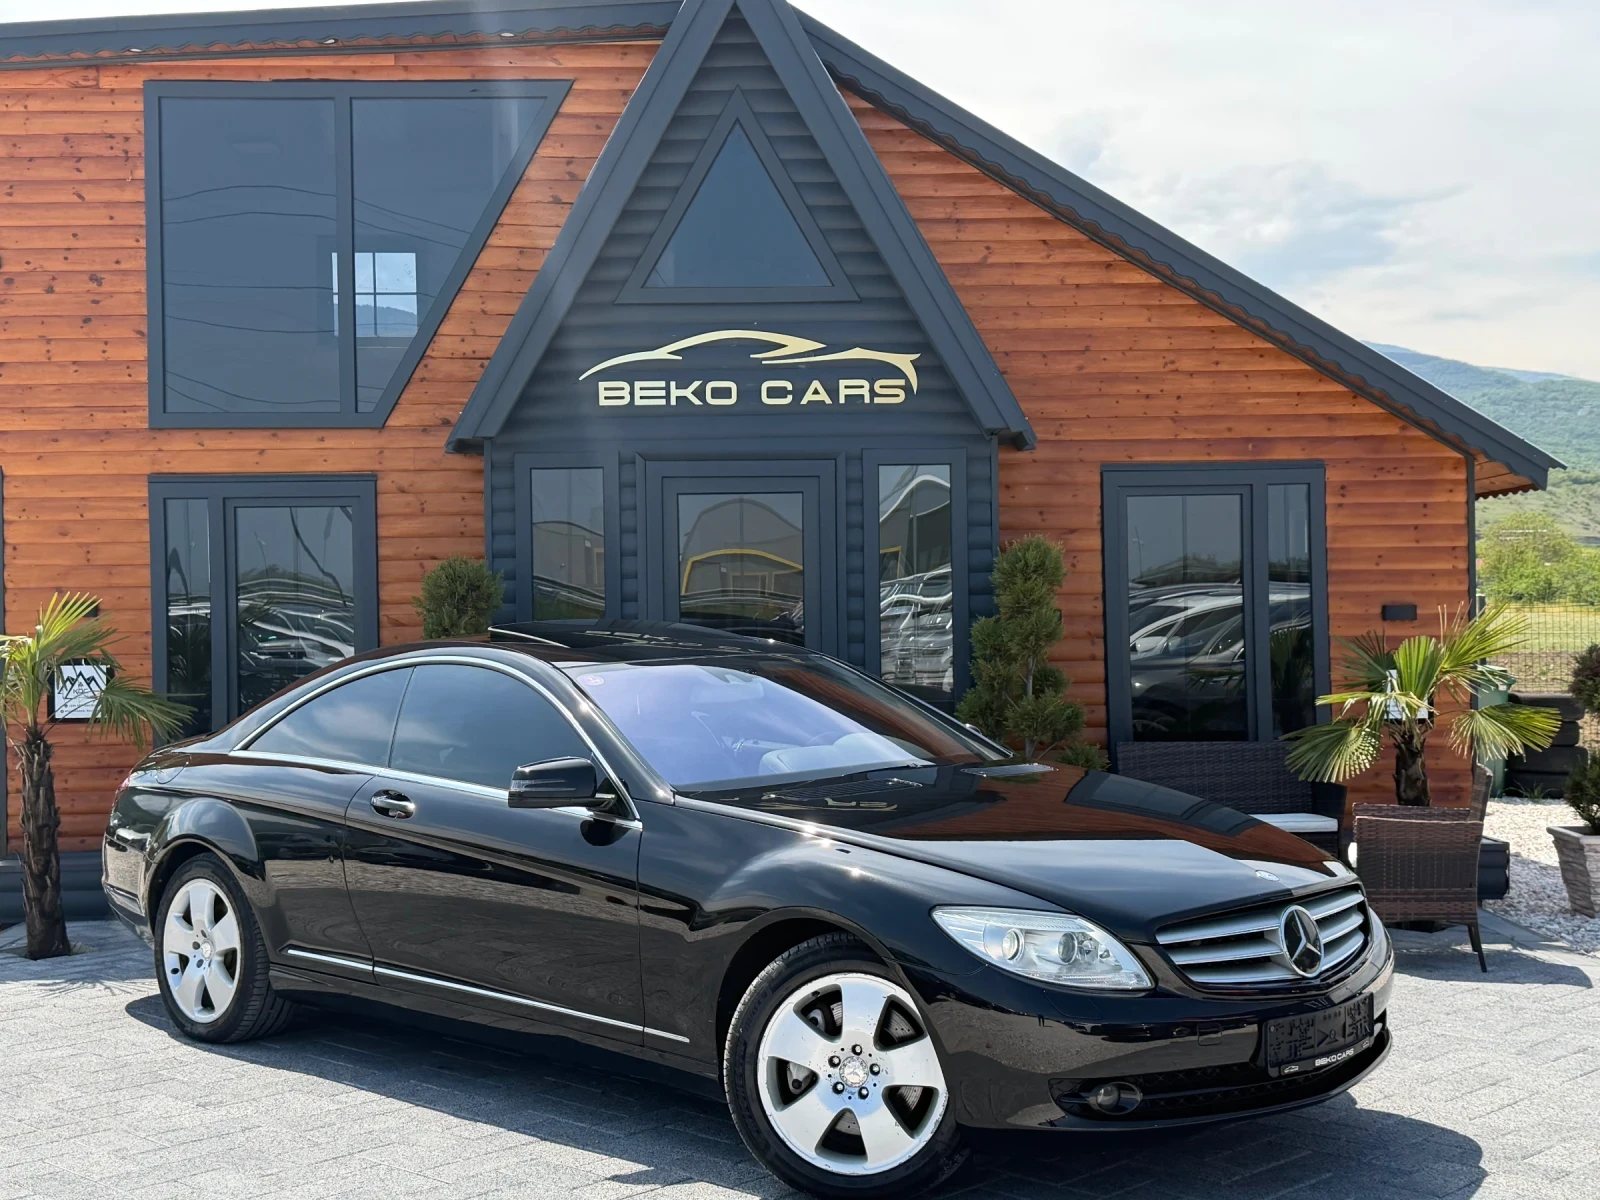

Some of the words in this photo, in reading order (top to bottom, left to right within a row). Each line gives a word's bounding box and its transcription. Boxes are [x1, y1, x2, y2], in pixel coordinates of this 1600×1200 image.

[598, 380, 738, 406] BEKO
[761, 379, 906, 405] CARS
[1314, 1054, 1337, 1067] BEKO
[1336, 1047, 1355, 1061] CARS
